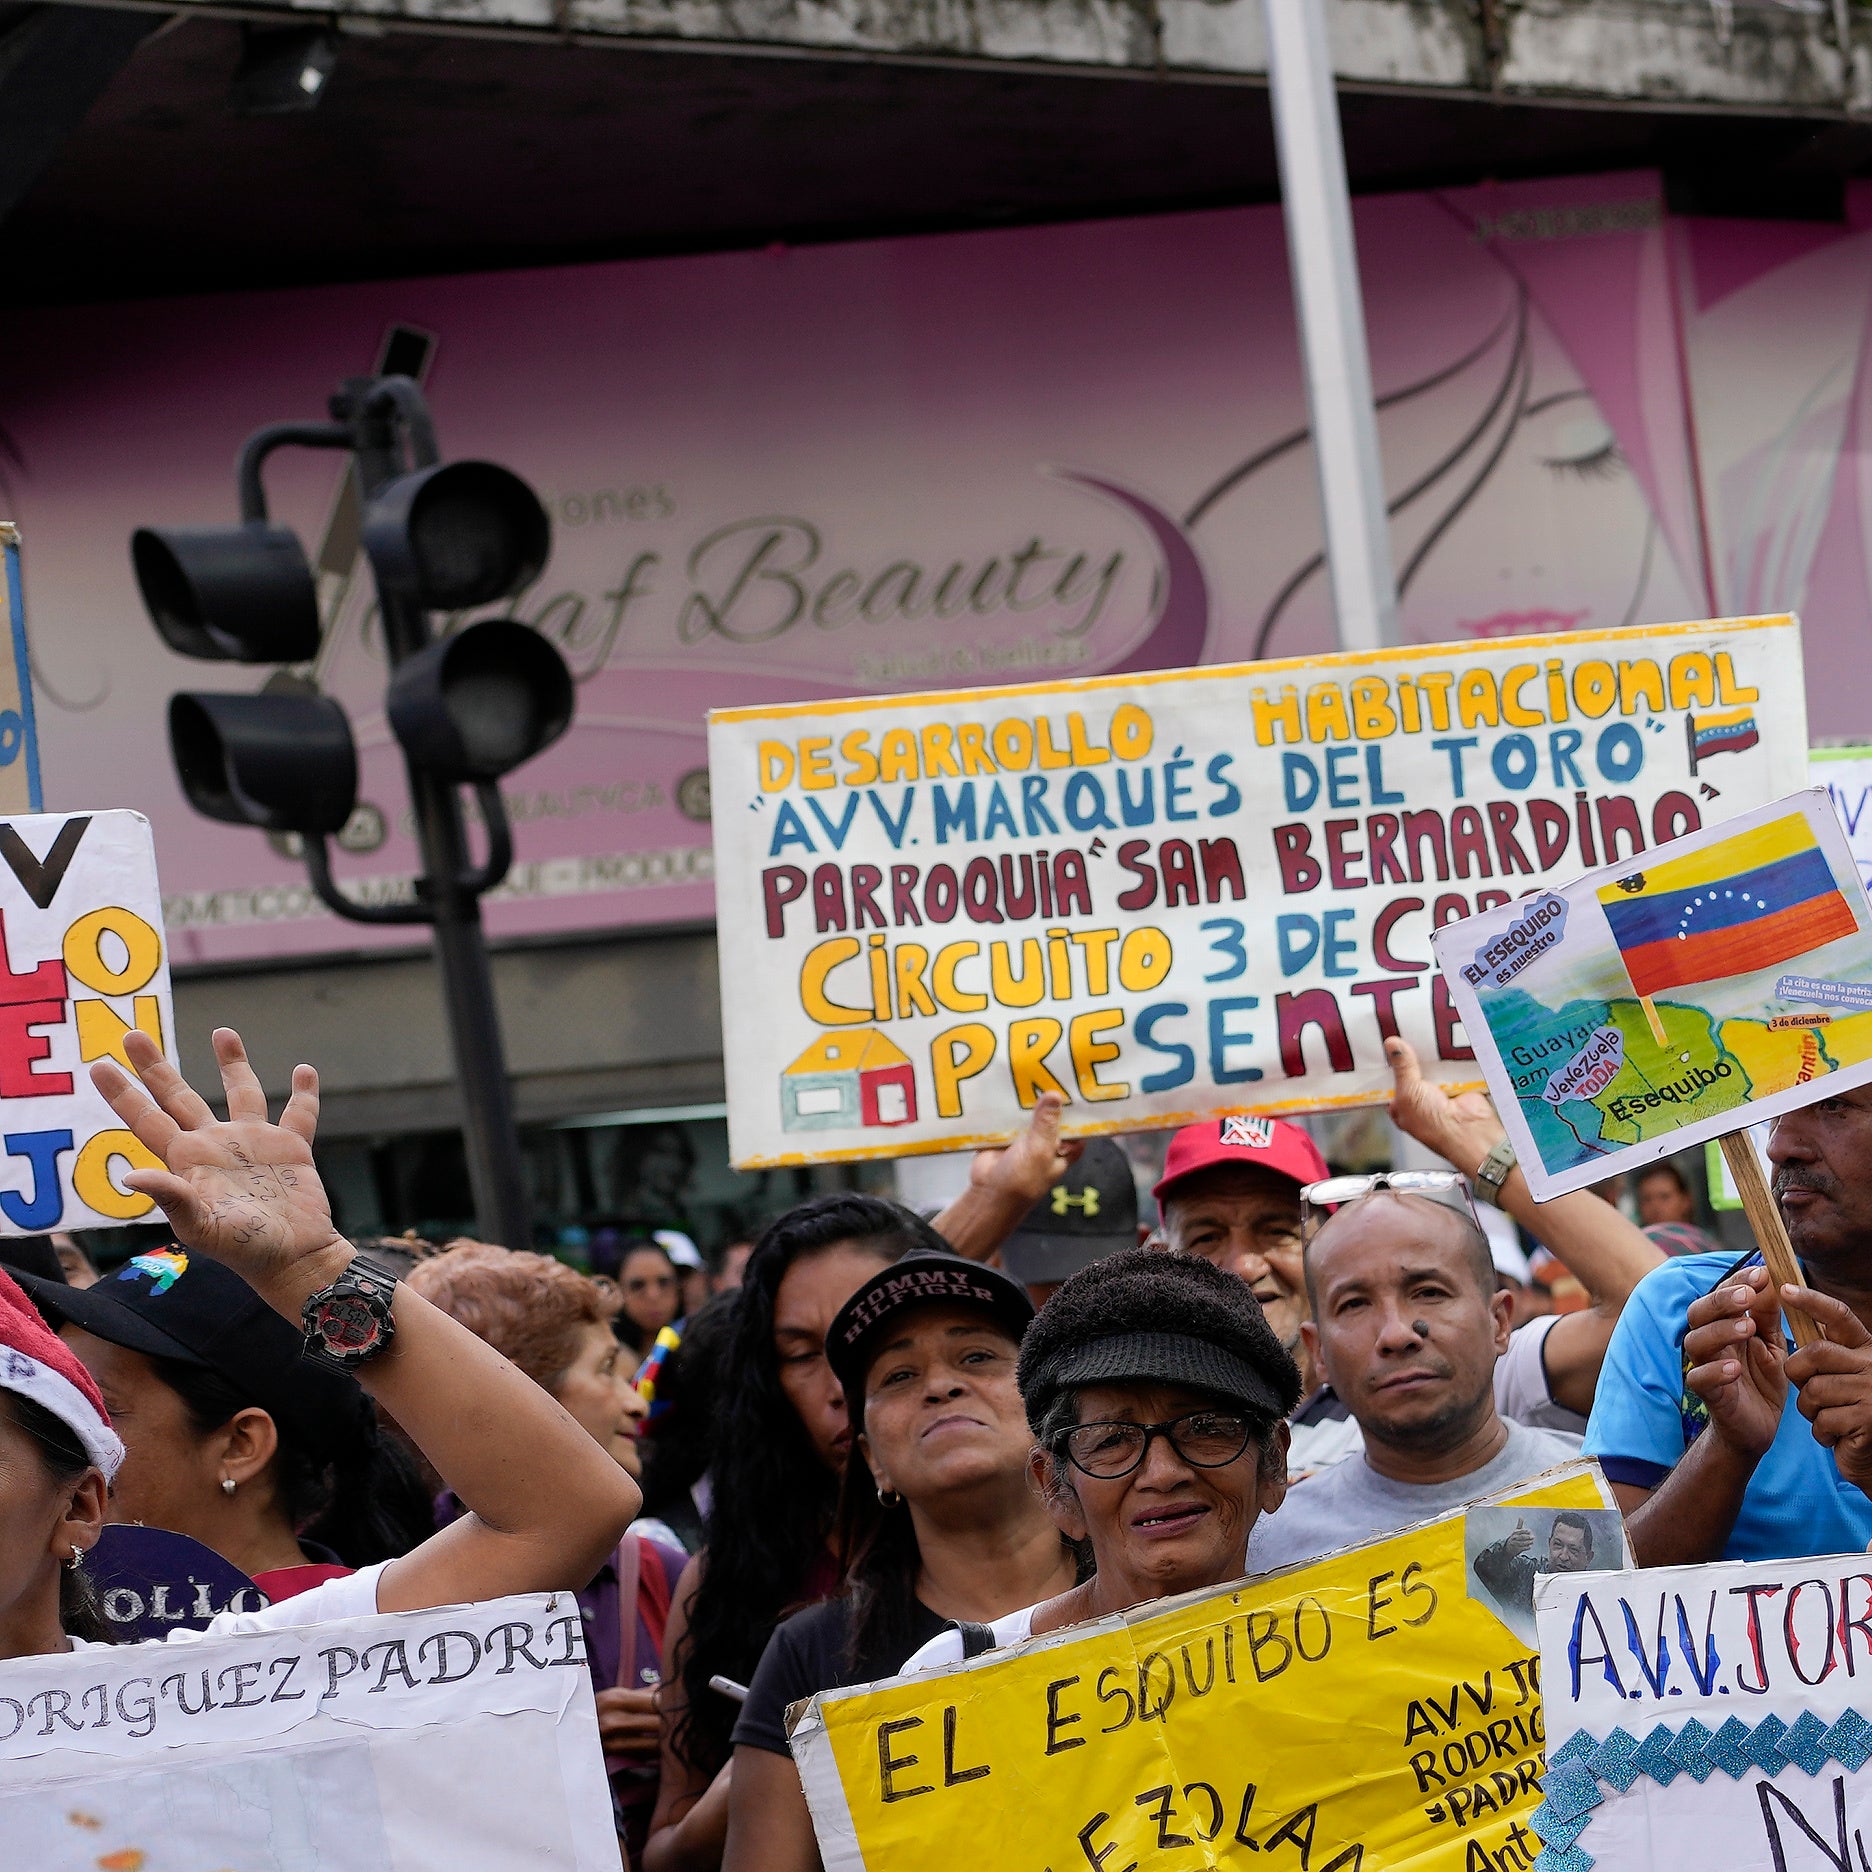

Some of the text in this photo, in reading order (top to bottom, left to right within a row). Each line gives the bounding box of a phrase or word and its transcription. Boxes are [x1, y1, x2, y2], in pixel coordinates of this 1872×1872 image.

[677, 515, 1127, 646] Beauty
[759, 704, 1153, 793] DESARROLLO
[933, 745, 1243, 844] MARQUÉS
[1283, 744, 1404, 811] DEL
[1201, 917, 1248, 983] 3
[1276, 908, 1358, 978] DE
[1464, 962, 1489, 986] EL
[1484, 899, 1563, 967] ESEQUIBO
[1495, 931, 1556, 984] es nuestro
[1783, 977, 1793, 986] La
[1821, 983, 1837, 992] con
[1772, 1015, 1831, 1028] 3 de diciembre
[1575, 1058, 1620, 1098] TODA
[1607, 1058, 1733, 1122] Esequibo
[843, 1283, 995, 1344] HILFIGER
[850, 1270, 969, 1318] TOMMY
[318, 1614, 588, 1700] PADRE
[878, 1561, 1437, 1802] EL ESQUIBO ES
